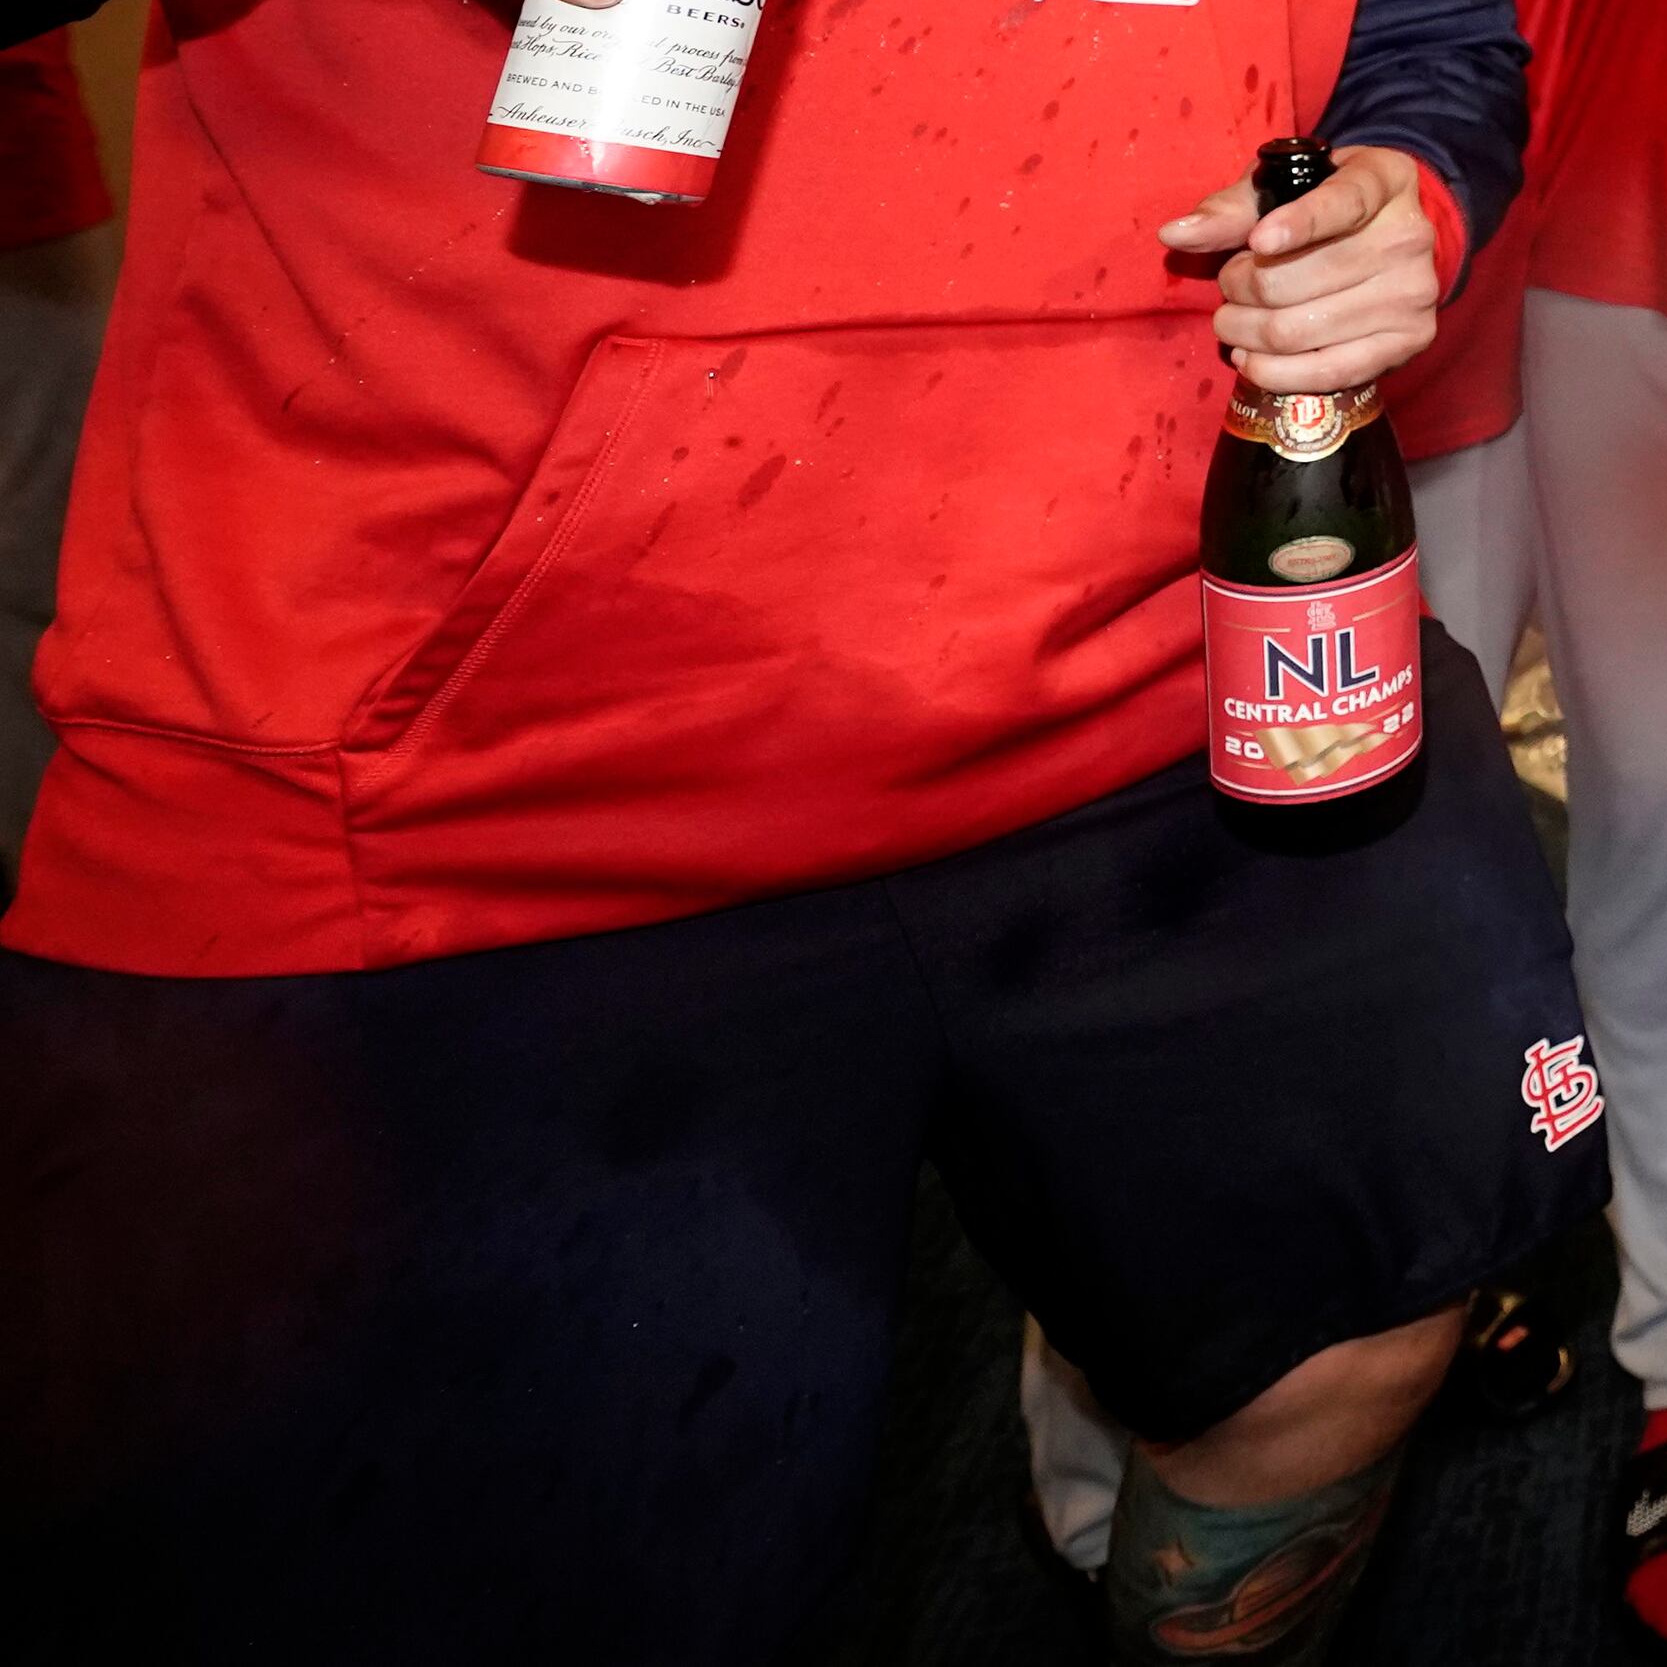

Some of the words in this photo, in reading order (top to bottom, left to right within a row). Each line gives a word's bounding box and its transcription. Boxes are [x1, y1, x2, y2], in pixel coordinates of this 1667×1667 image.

[560, 22, 587, 36] our
[668, 40, 720, 63] process
[506, 72, 548, 87] BREWED
[552, 81, 583, 94] AND
[666, 100, 680, 110] IN
[686, 102, 707, 115] THE
[1263, 626, 1380, 701] NL
[1224, 696, 1328, 724] CENTRAL
[1332, 665, 1414, 716] CHAMPS
